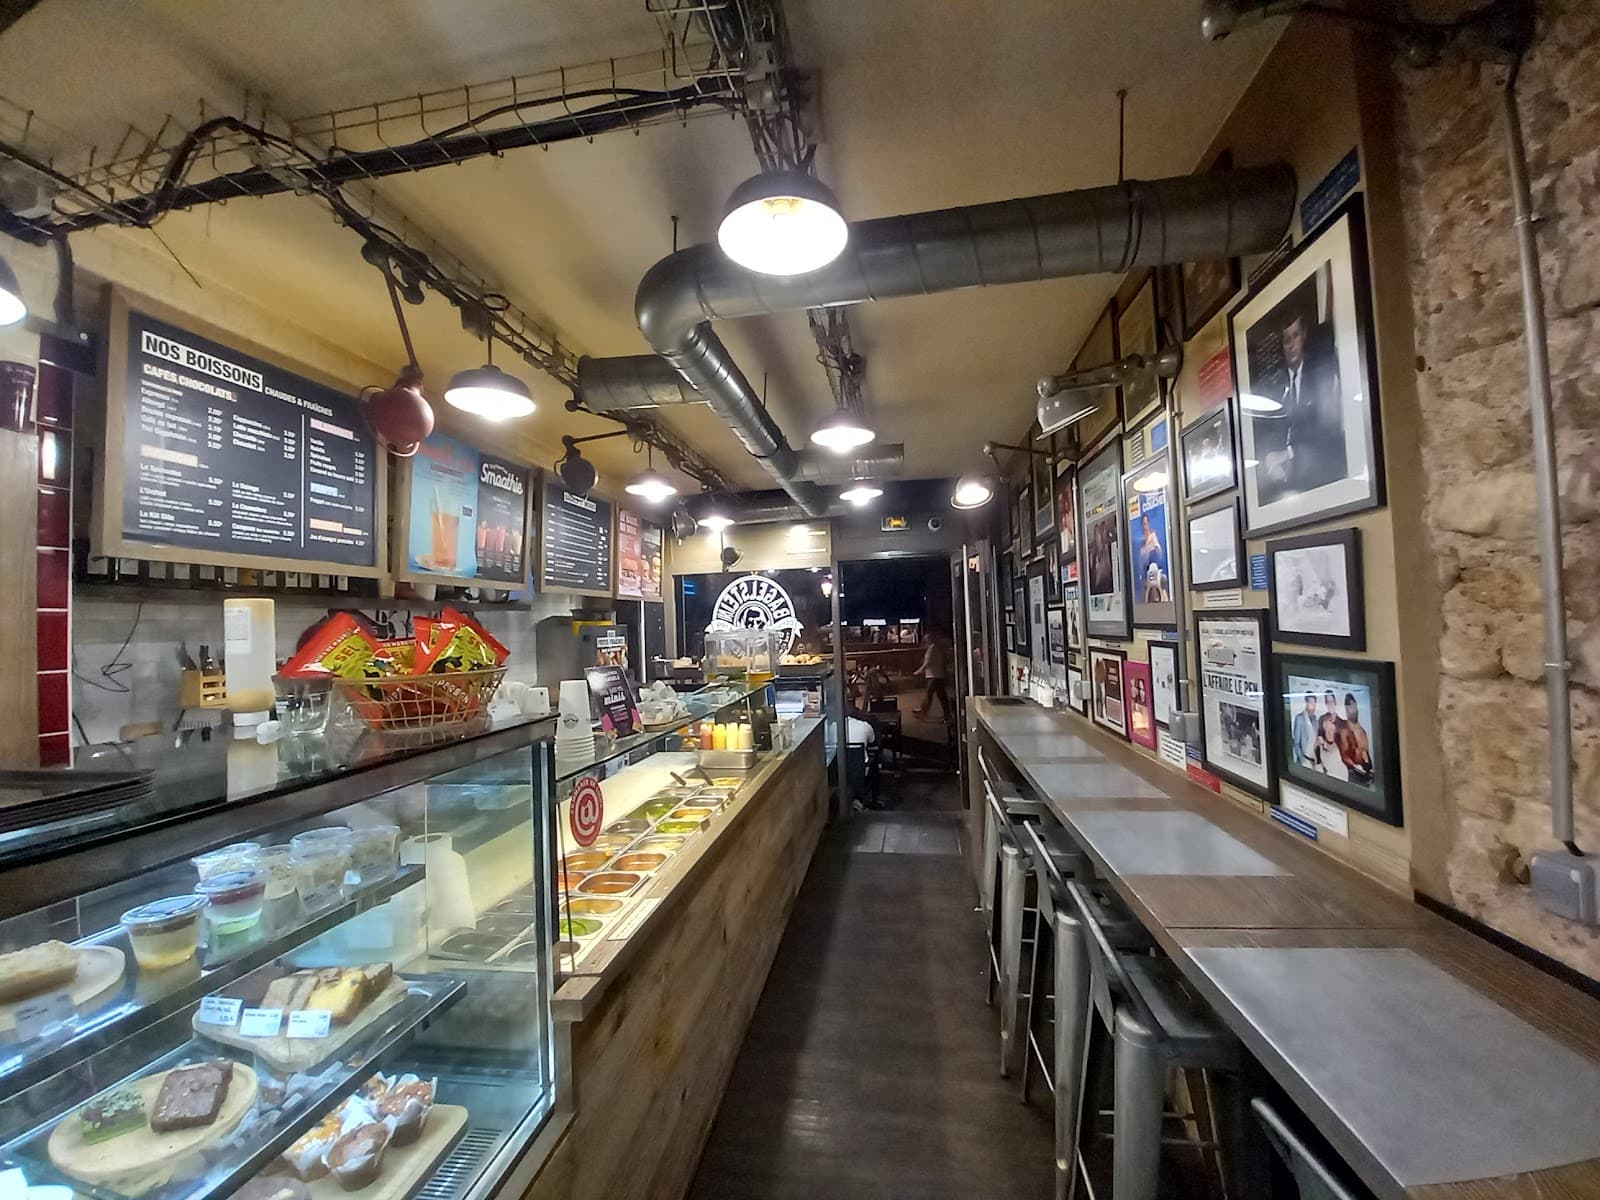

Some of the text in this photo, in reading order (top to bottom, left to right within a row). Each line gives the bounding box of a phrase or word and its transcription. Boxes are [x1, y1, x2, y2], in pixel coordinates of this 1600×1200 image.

[145, 335, 180, 361] NOS
[186, 349, 261, 389] BOISSONS
[480, 463, 524, 496] Smoothie
[335, 645, 361, 662] SEL
[1234, 679, 1243, 696] LE
